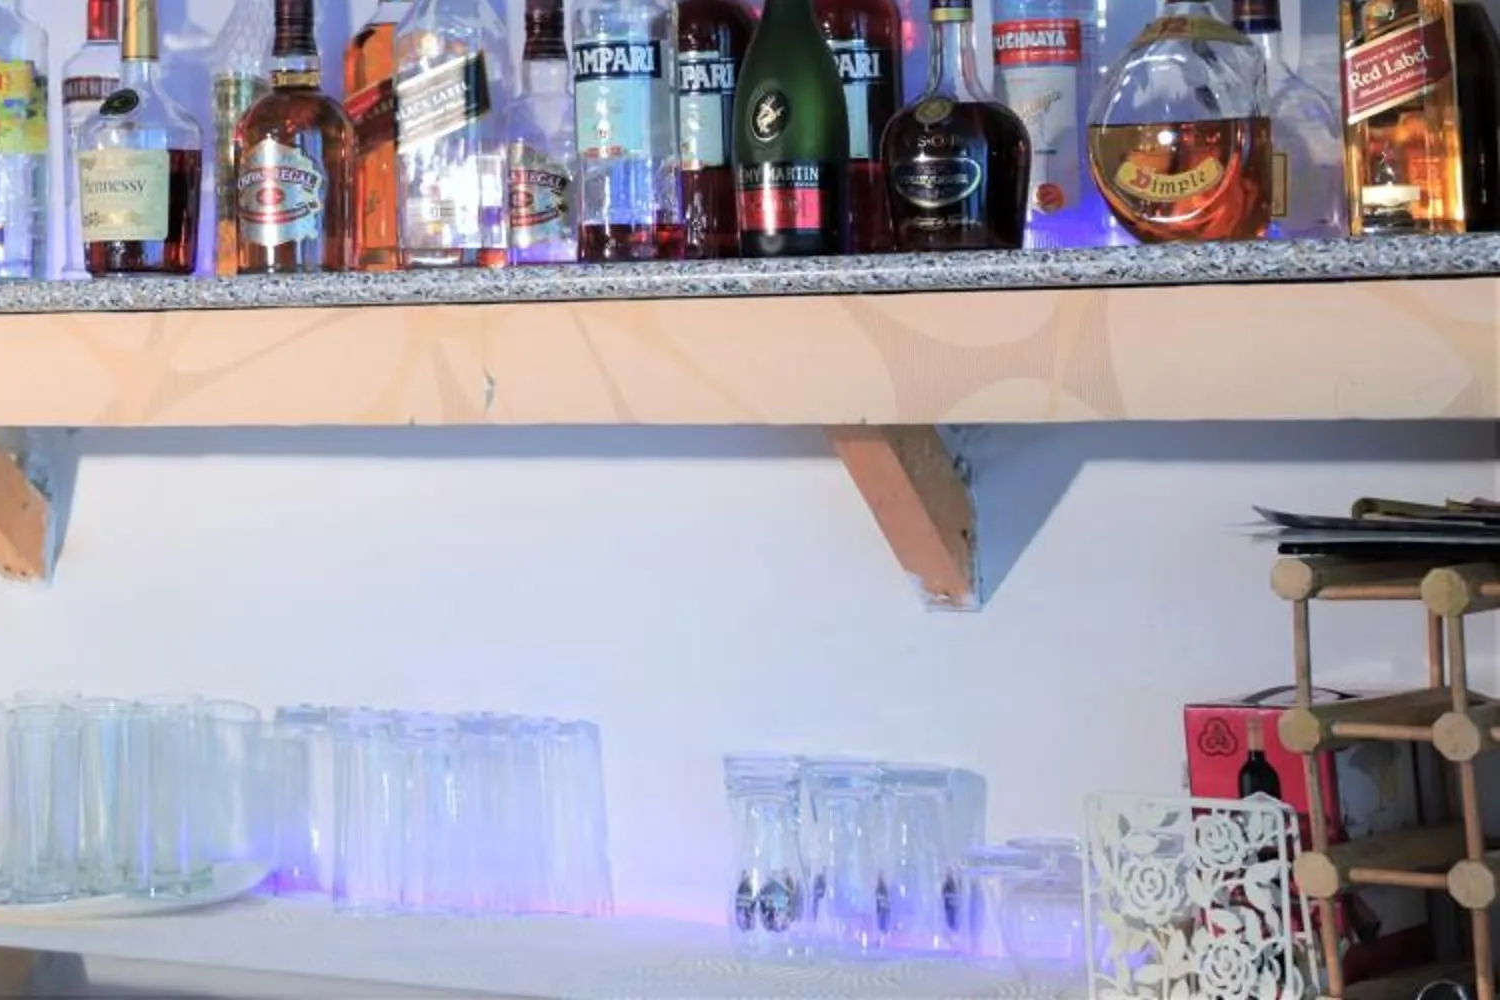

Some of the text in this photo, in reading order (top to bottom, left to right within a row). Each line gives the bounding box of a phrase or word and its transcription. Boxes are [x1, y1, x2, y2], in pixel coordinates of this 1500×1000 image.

[576, 45, 655, 75] AMPARI
[1350, 64, 1383, 90] Red
[1383, 45, 1429, 76] Label
[681, 63, 735, 90] PARI
[765, 166, 819, 181] MARTIN
